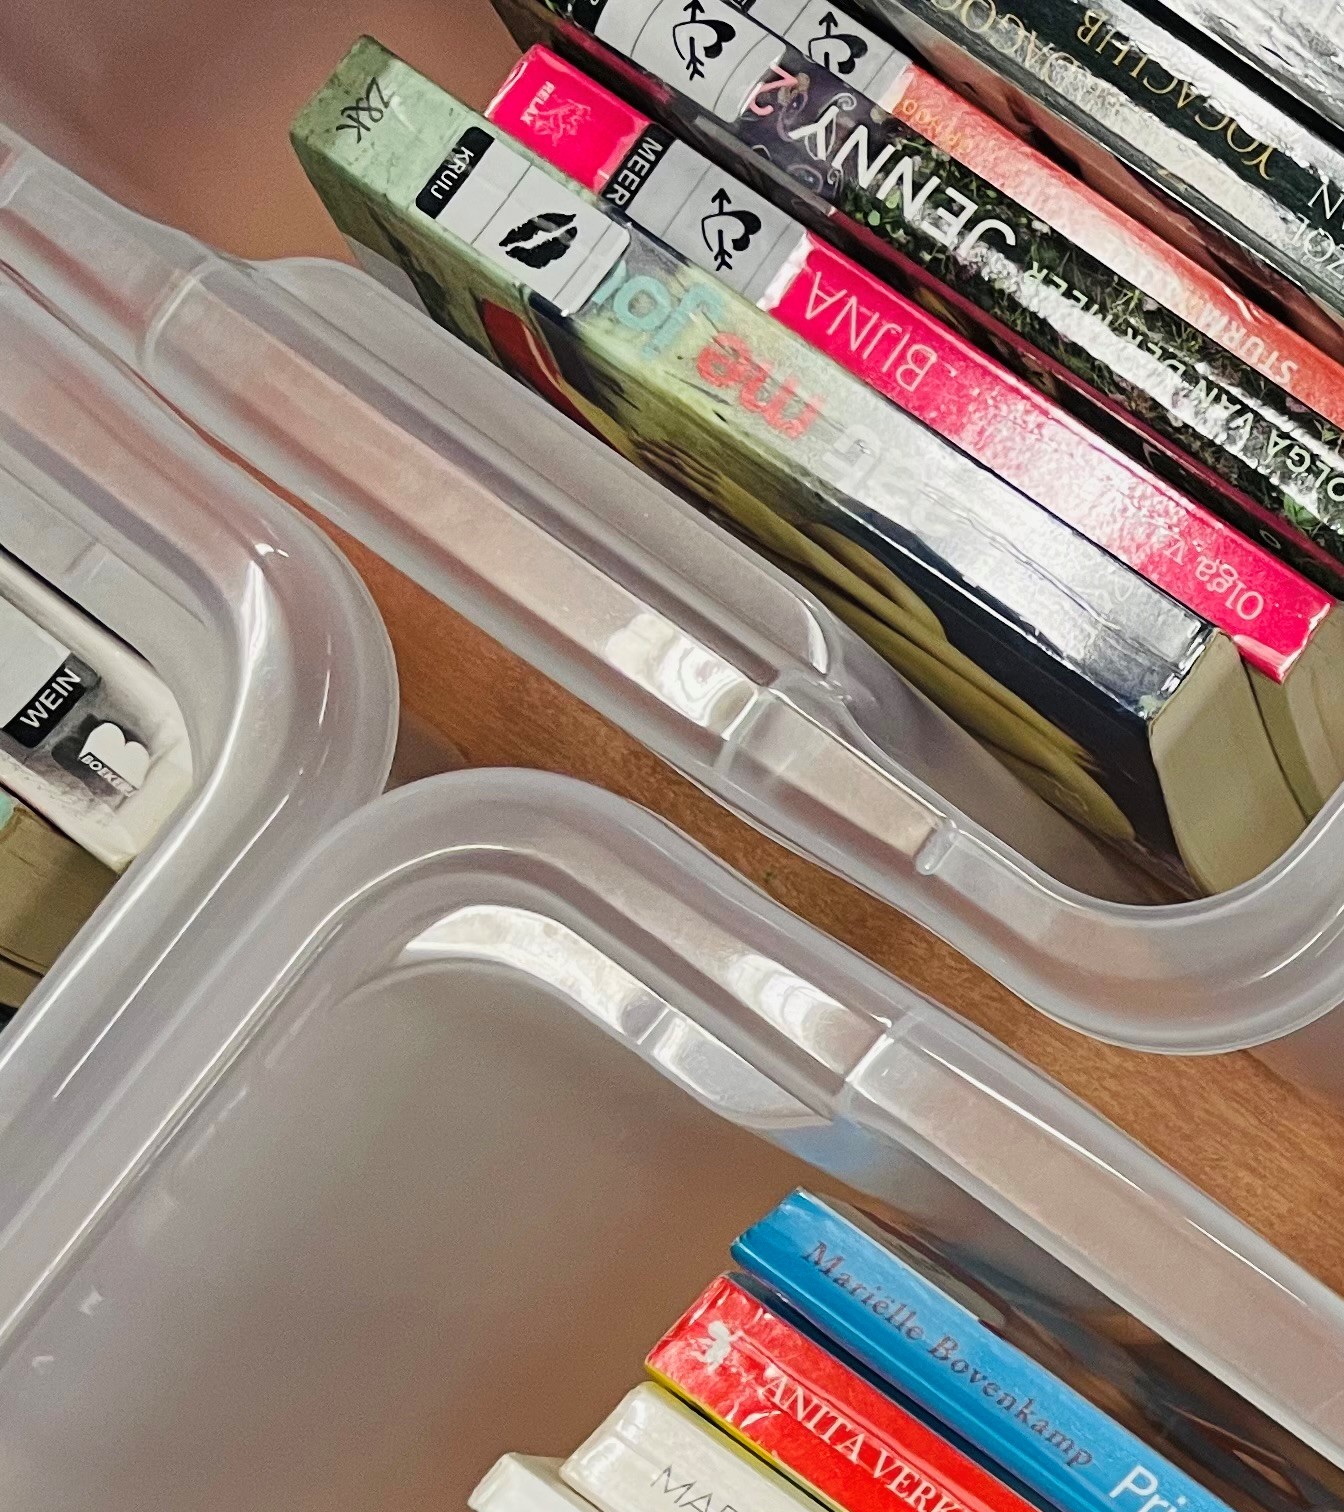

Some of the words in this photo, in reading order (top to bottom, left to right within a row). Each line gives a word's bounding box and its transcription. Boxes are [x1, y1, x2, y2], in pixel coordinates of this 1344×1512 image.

[329, 71, 396, 146] Z&K
[517, 77, 558, 126] RELAX
[425, 141, 475, 200] KRUIJ
[602, 133, 664, 208] MEER
[784, 88, 1023, 281] JENNY
[790, 268, 939, 394] BIJNA
[687, 322, 828, 445] me
[1187, 374, 1262, 438] VAN
[1184, 541, 1276, 625] Olga
[18, 663, 81, 735] WEIN
[756, 1369, 873, 1465] ANITA
[919, 1330, 1105, 1478] Bovenkamp
